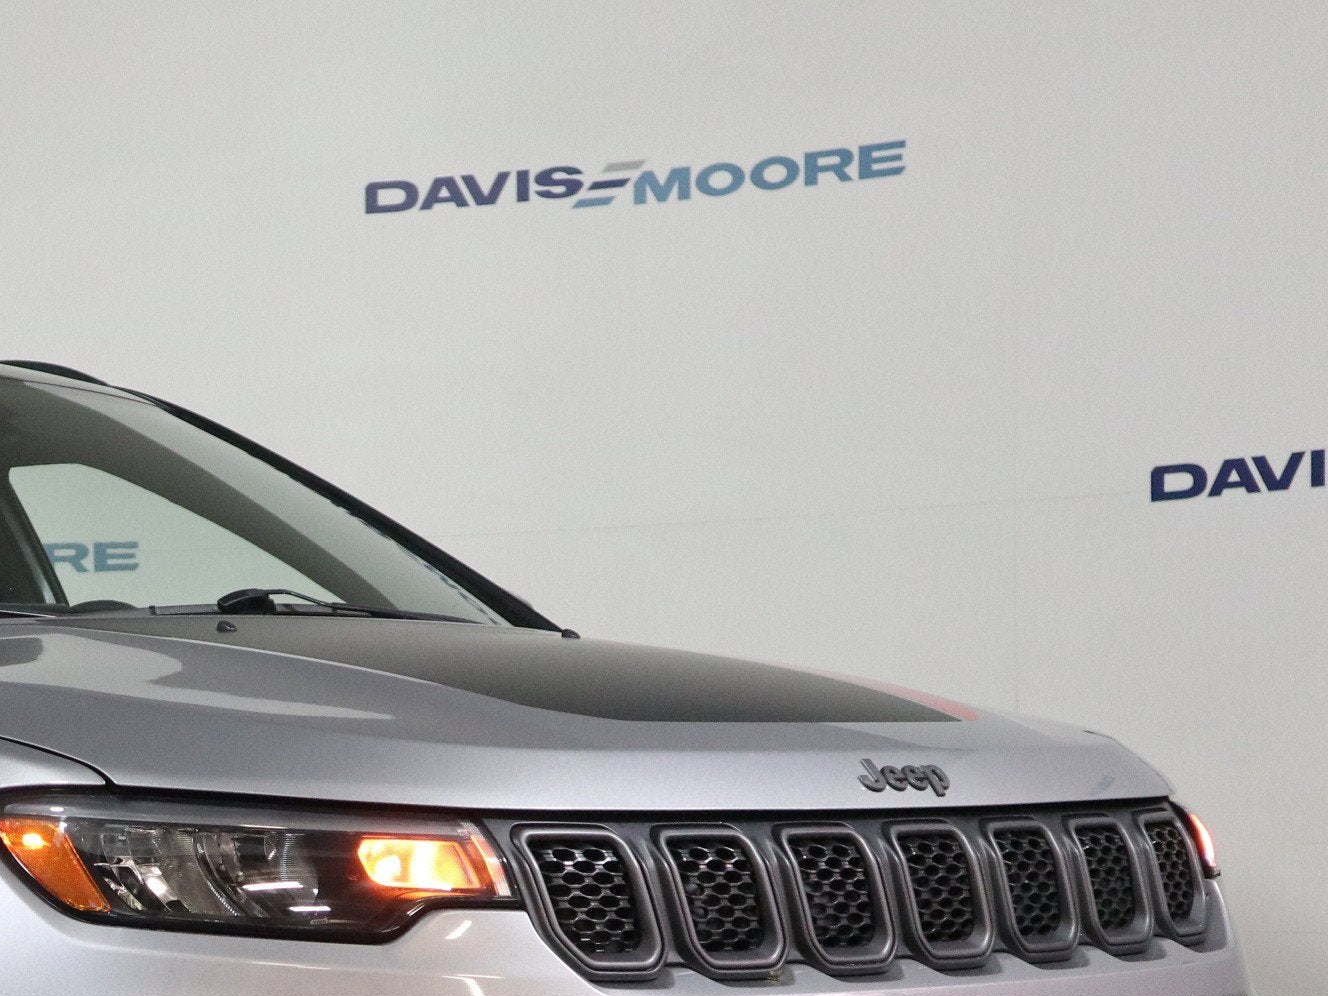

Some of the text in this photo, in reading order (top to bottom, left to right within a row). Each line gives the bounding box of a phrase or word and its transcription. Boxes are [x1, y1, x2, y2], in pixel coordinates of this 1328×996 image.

[364, 139, 907, 215] DAVIS MOORE
[857, 758, 951, 797] Jeep
